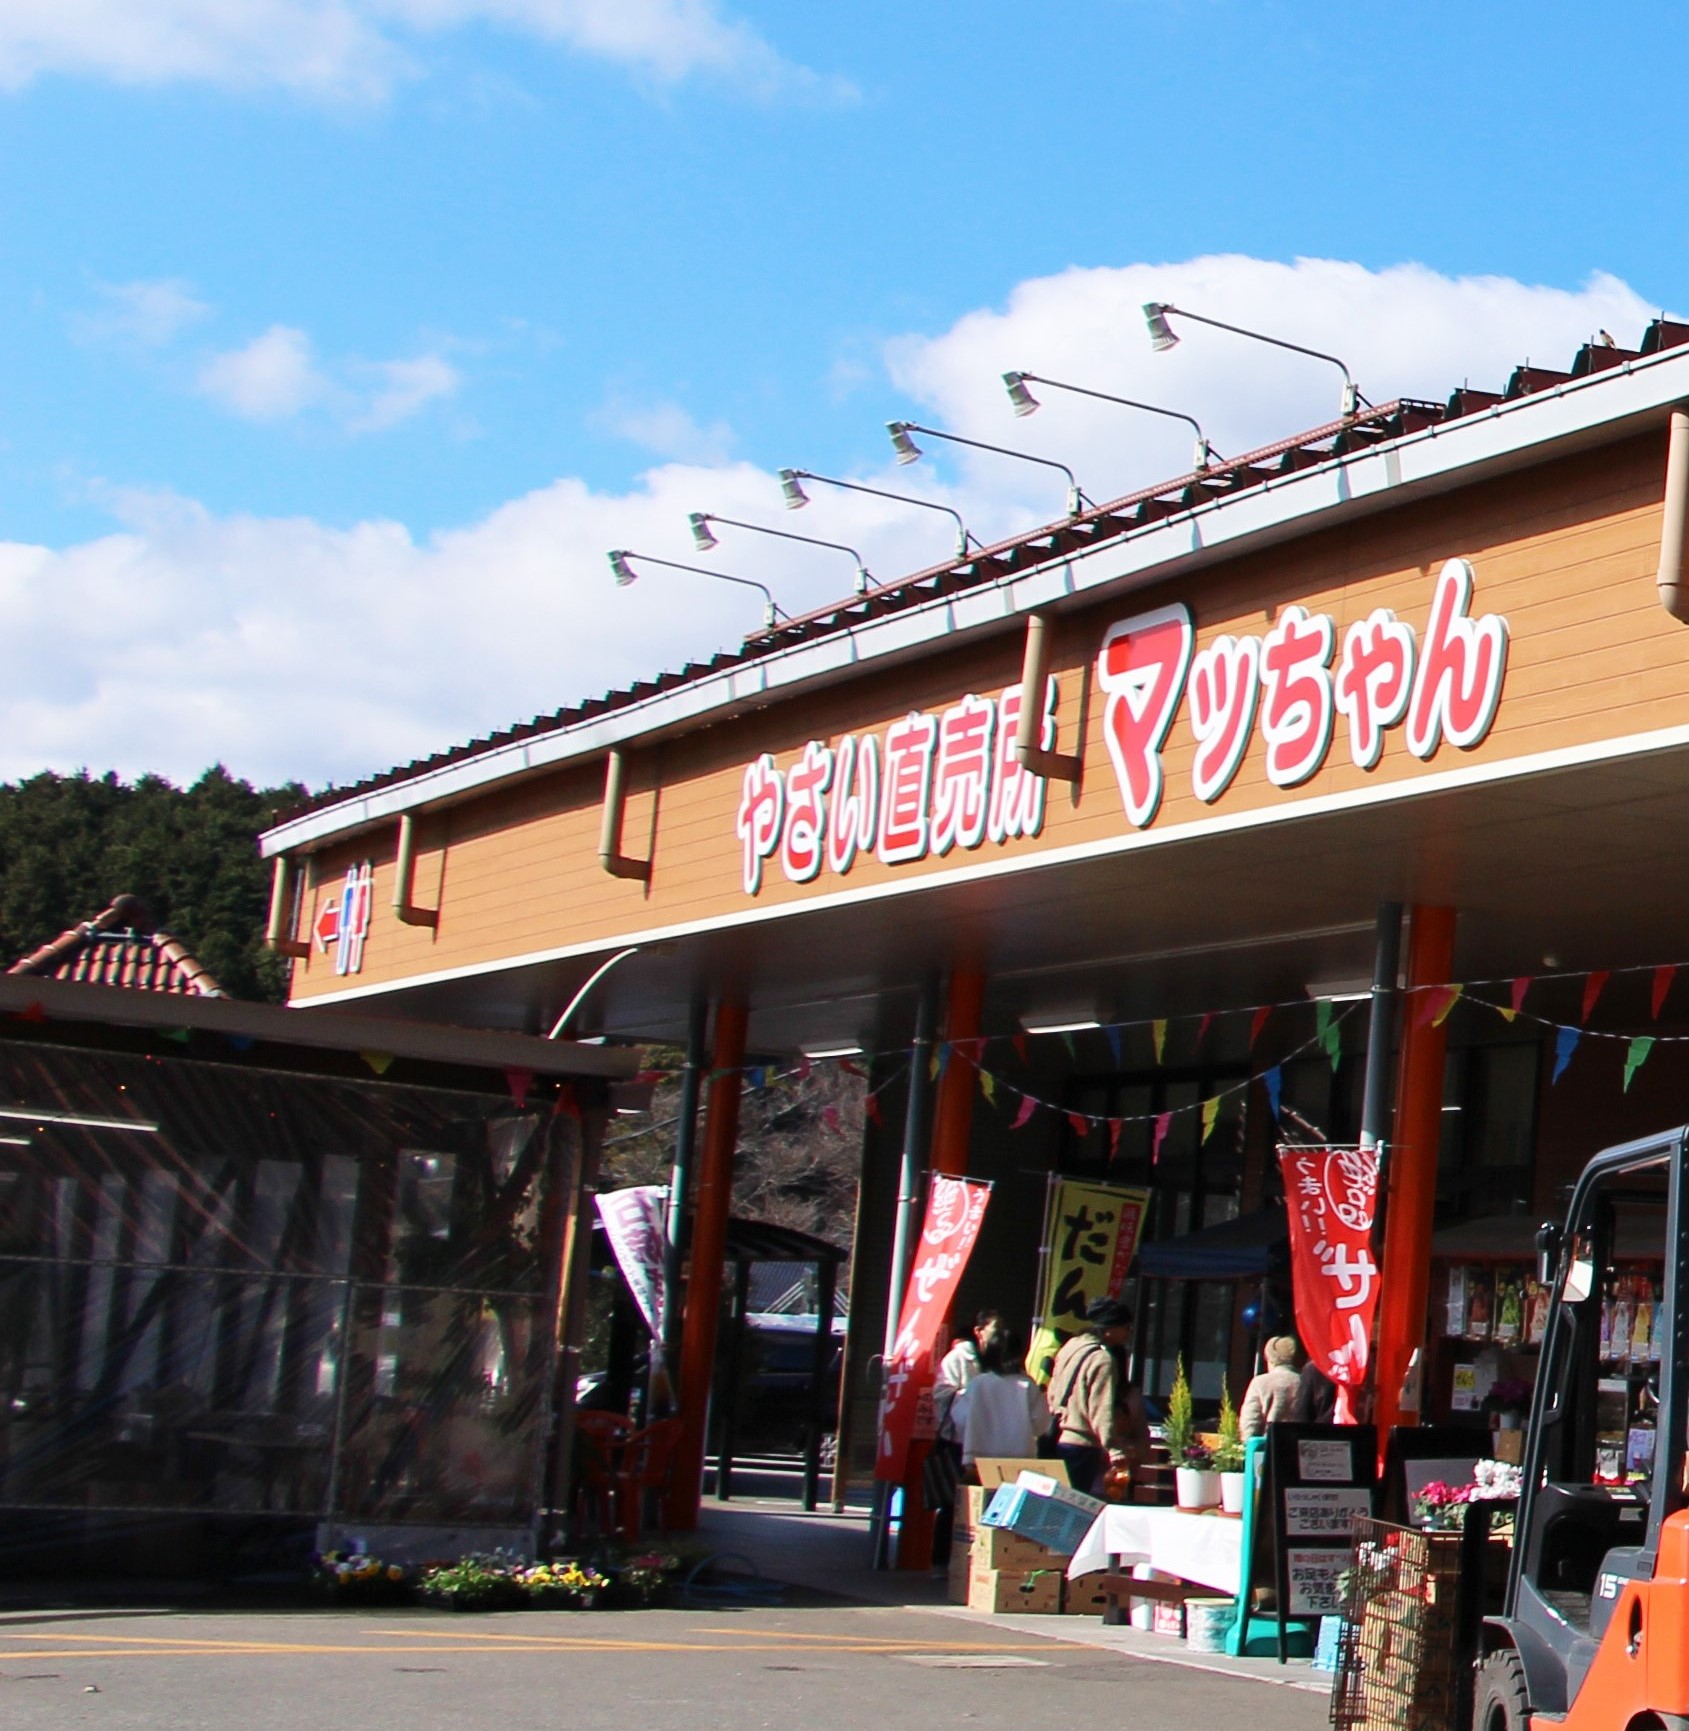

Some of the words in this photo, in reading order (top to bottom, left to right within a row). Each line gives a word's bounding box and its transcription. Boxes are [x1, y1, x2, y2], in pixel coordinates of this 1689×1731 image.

[1098, 558, 1508, 827] マッちゃん
[1599, 1573, 1618, 1599] 15
